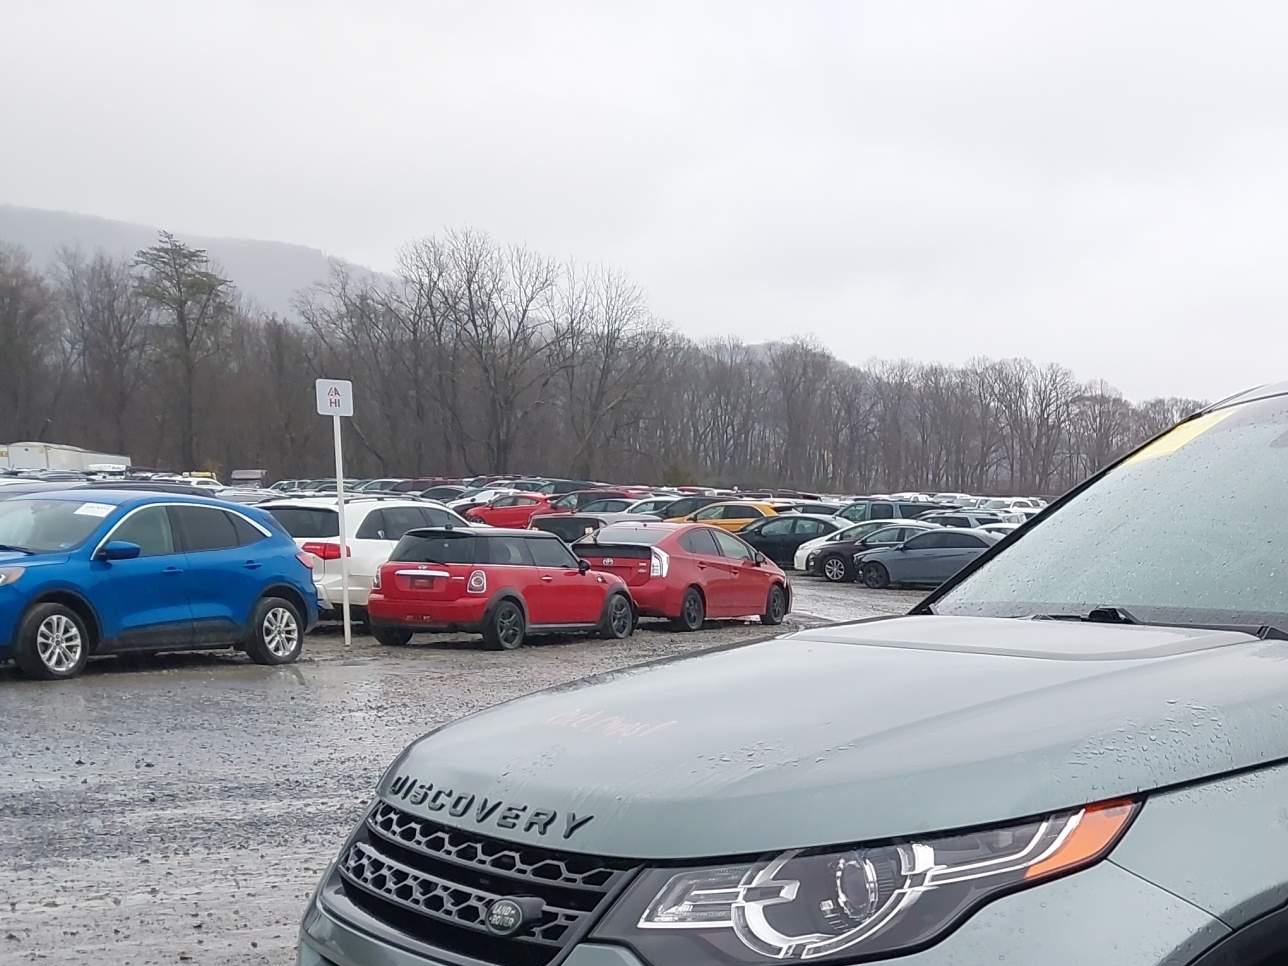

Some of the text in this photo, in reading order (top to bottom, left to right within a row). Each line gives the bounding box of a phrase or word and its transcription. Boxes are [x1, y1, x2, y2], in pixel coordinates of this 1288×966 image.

[390, 775, 595, 840] DISCOVERY
[492, 904, 513, 916] LAND
[491, 914, 515, 928] ROVER
